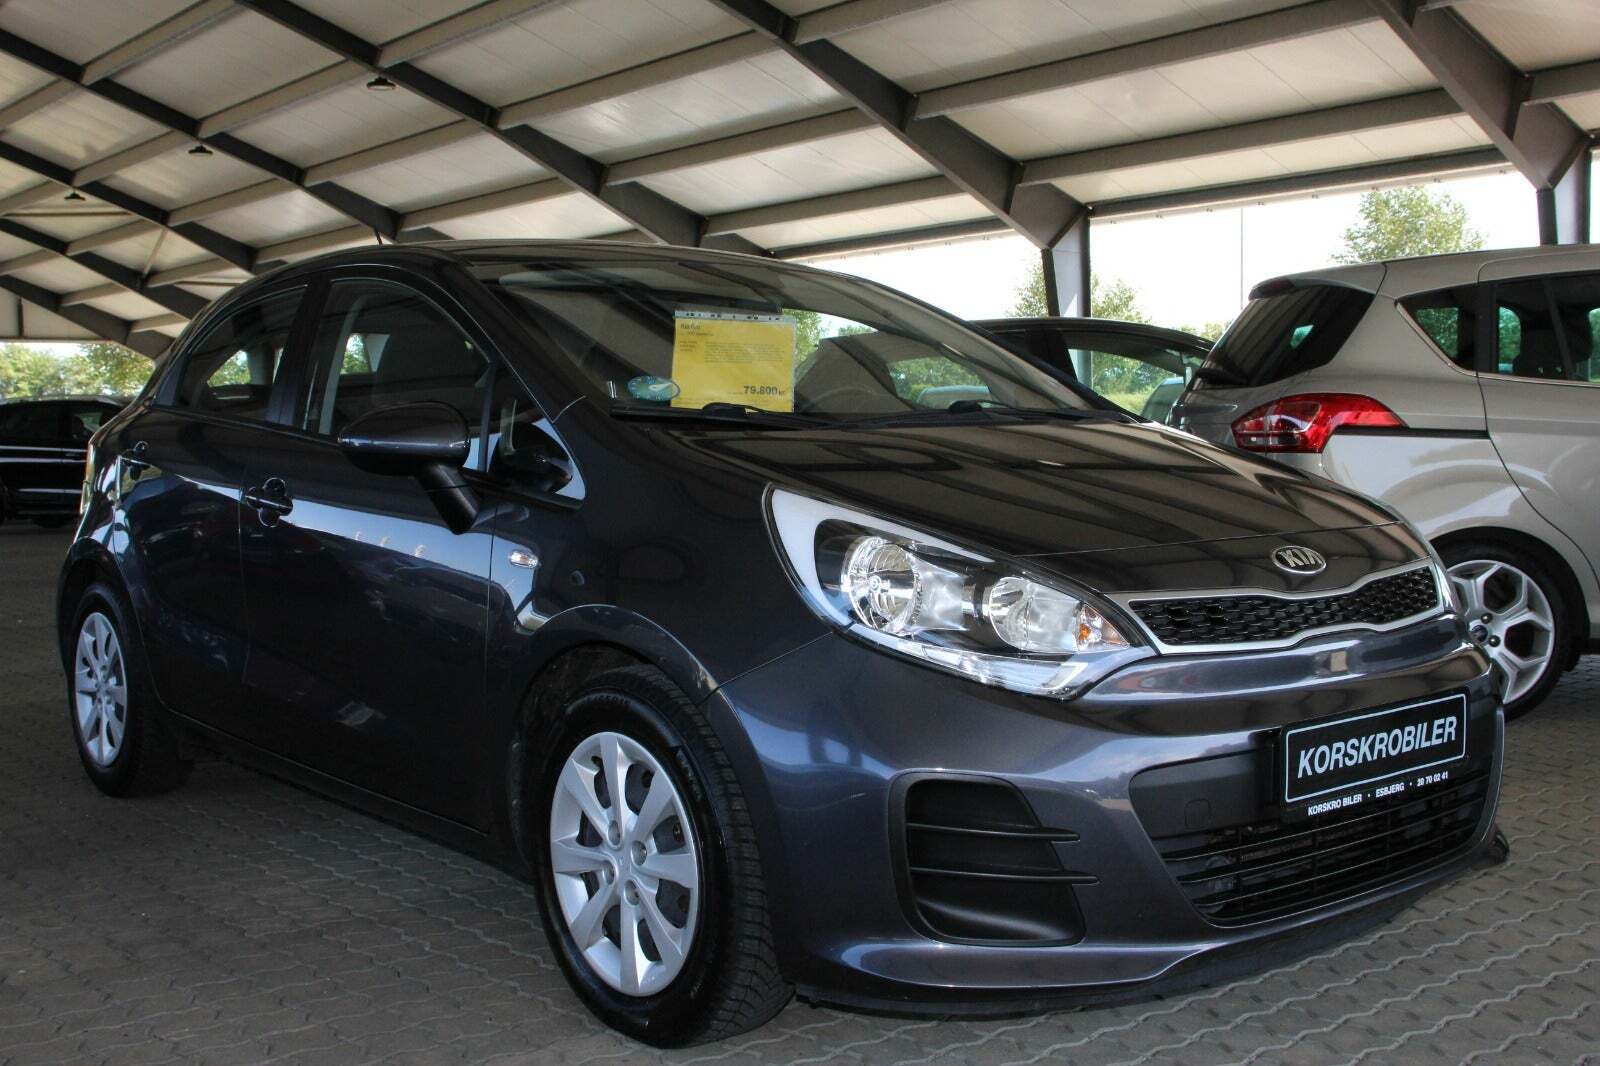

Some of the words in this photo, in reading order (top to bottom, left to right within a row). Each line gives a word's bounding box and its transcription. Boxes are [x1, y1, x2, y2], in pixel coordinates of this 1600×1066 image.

[1277, 547, 1323, 568] KIA
[1297, 716, 1458, 779] KORSKROBILER
[1308, 799, 1342, 816] KORSKRO
[1342, 793, 1363, 808] BILER
[1375, 782, 1405, 798] ESBJERG
[1425, 775, 1433, 785] 70
